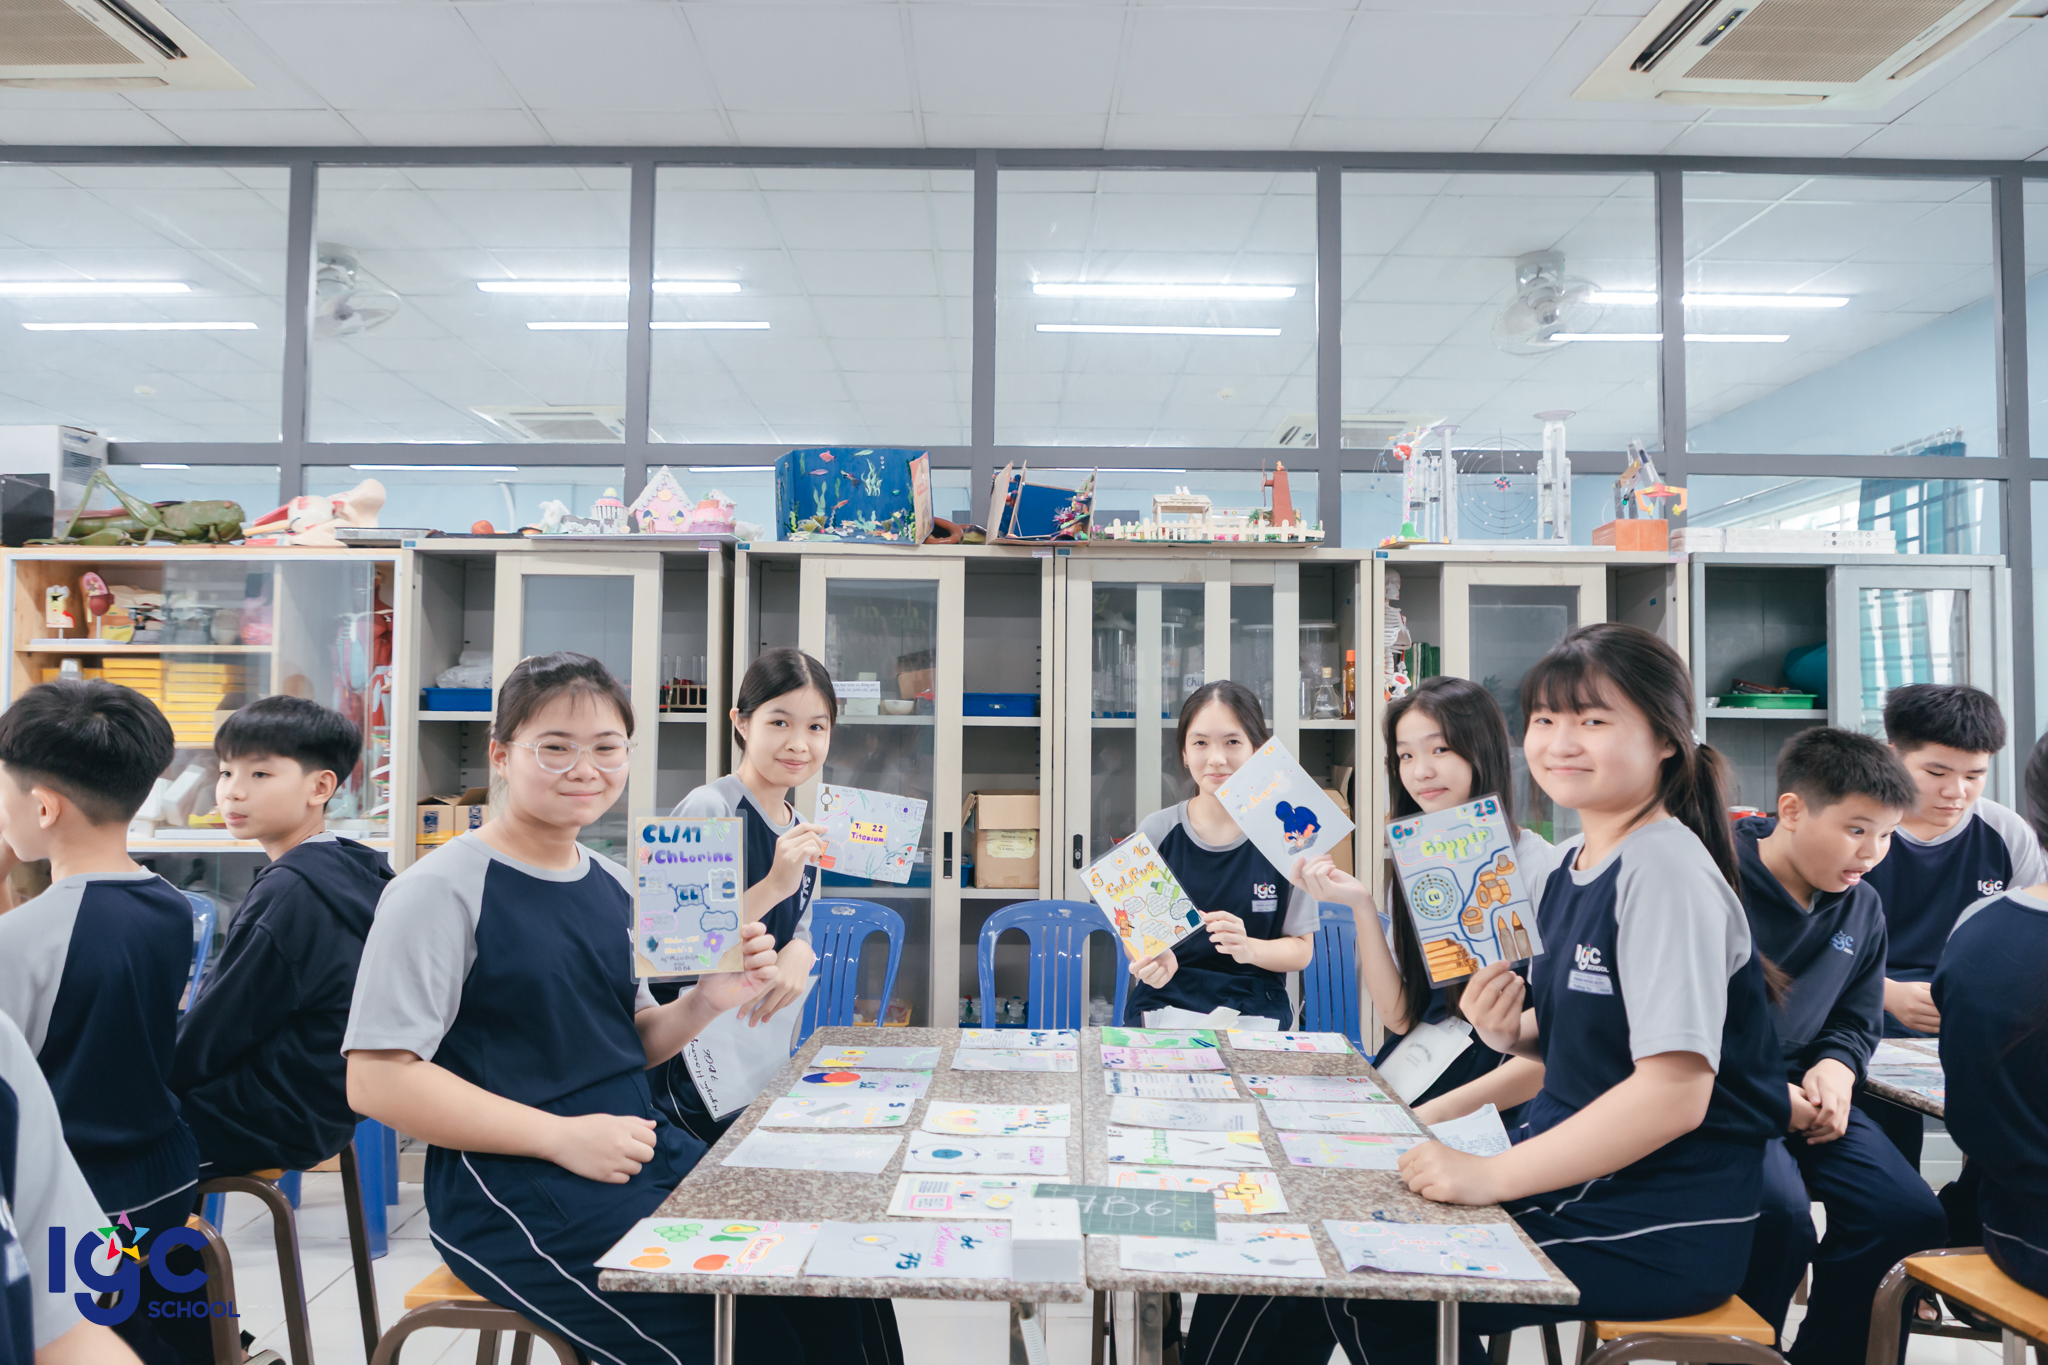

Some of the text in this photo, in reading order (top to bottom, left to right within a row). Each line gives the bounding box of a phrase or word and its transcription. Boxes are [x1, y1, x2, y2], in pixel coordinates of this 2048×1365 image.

[1474, 799, 1499, 817] 29
[851, 832, 884, 843] Titanium
[1133, 842, 1150, 858] 16
[1091, 872, 1104, 888] S
